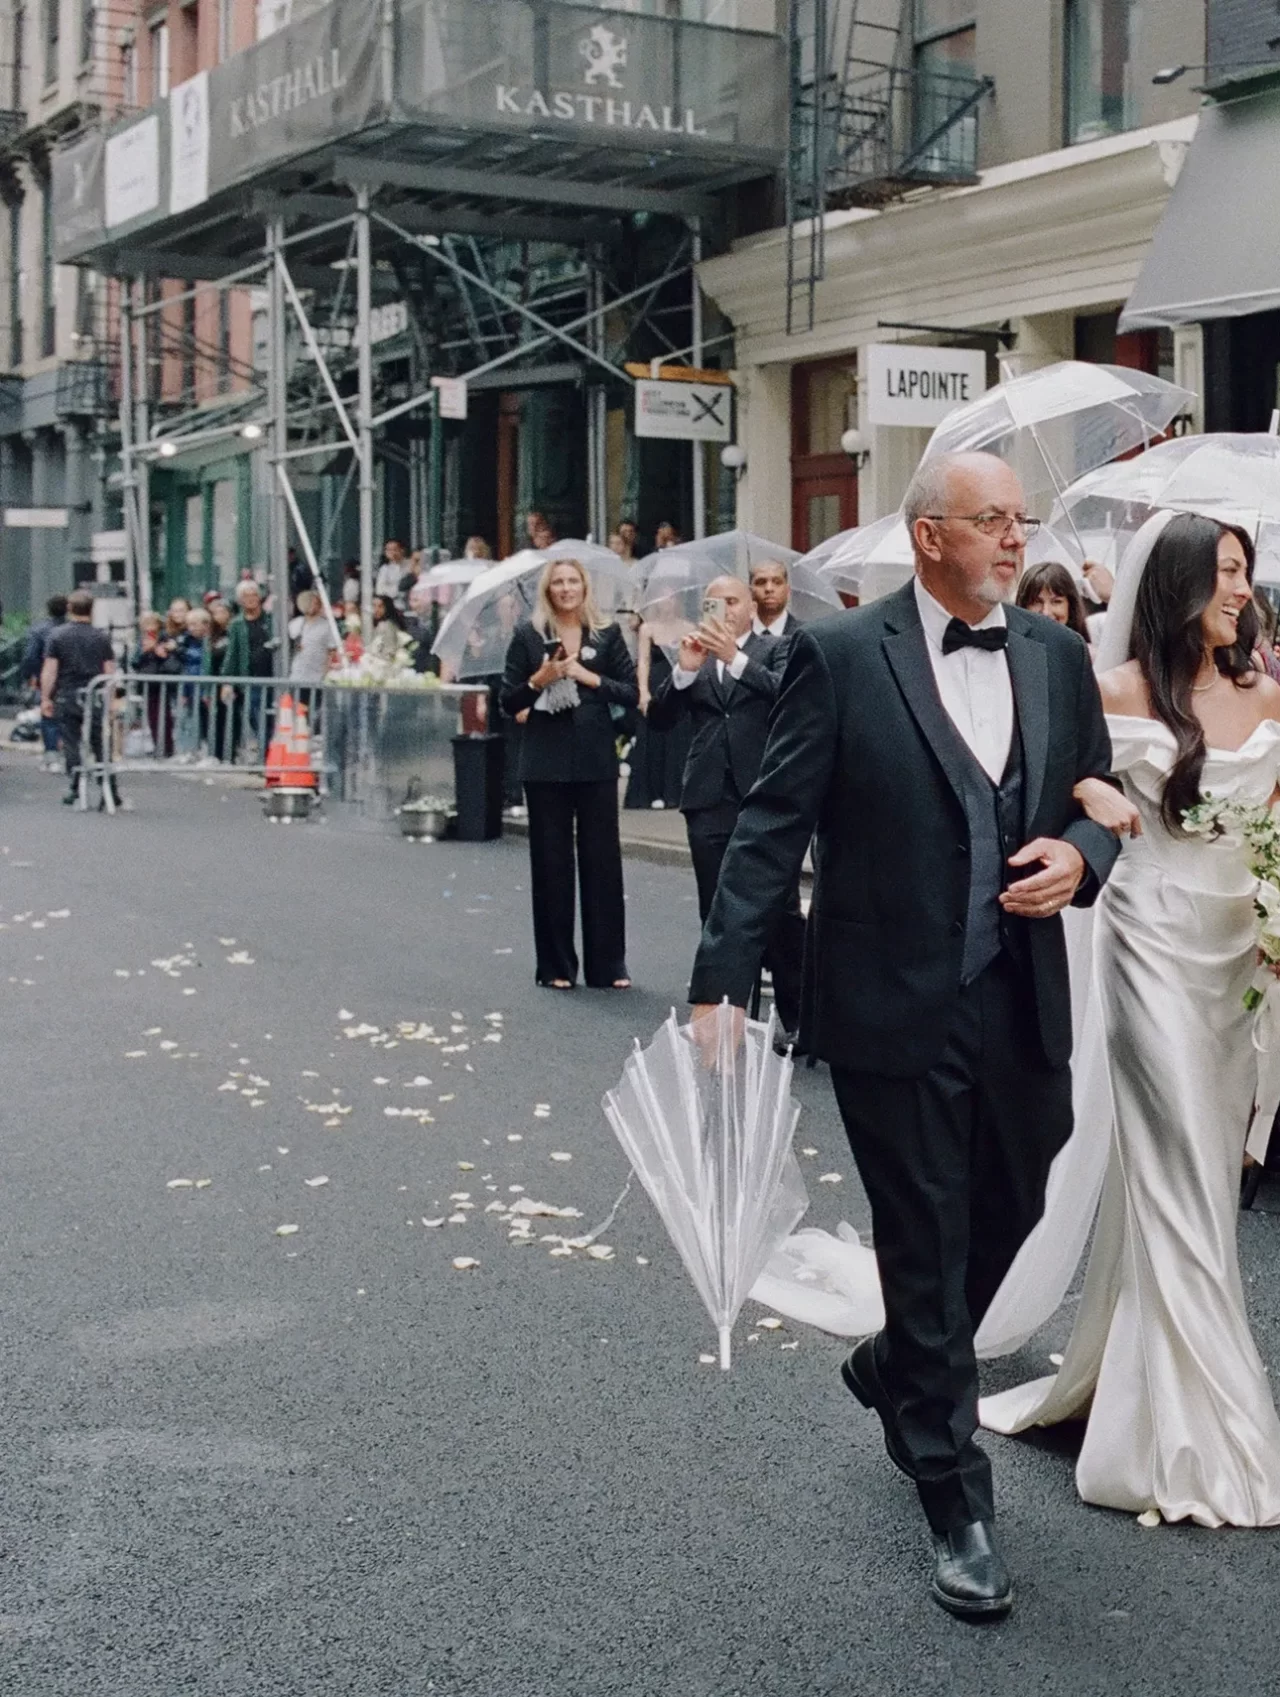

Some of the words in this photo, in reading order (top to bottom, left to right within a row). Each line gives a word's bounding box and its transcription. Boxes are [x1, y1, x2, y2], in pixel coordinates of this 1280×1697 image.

[230, 48, 347, 137] KASTHALL
[496, 85, 707, 135] KASTHALL
[887, 368, 969, 401] LAPOINTE
